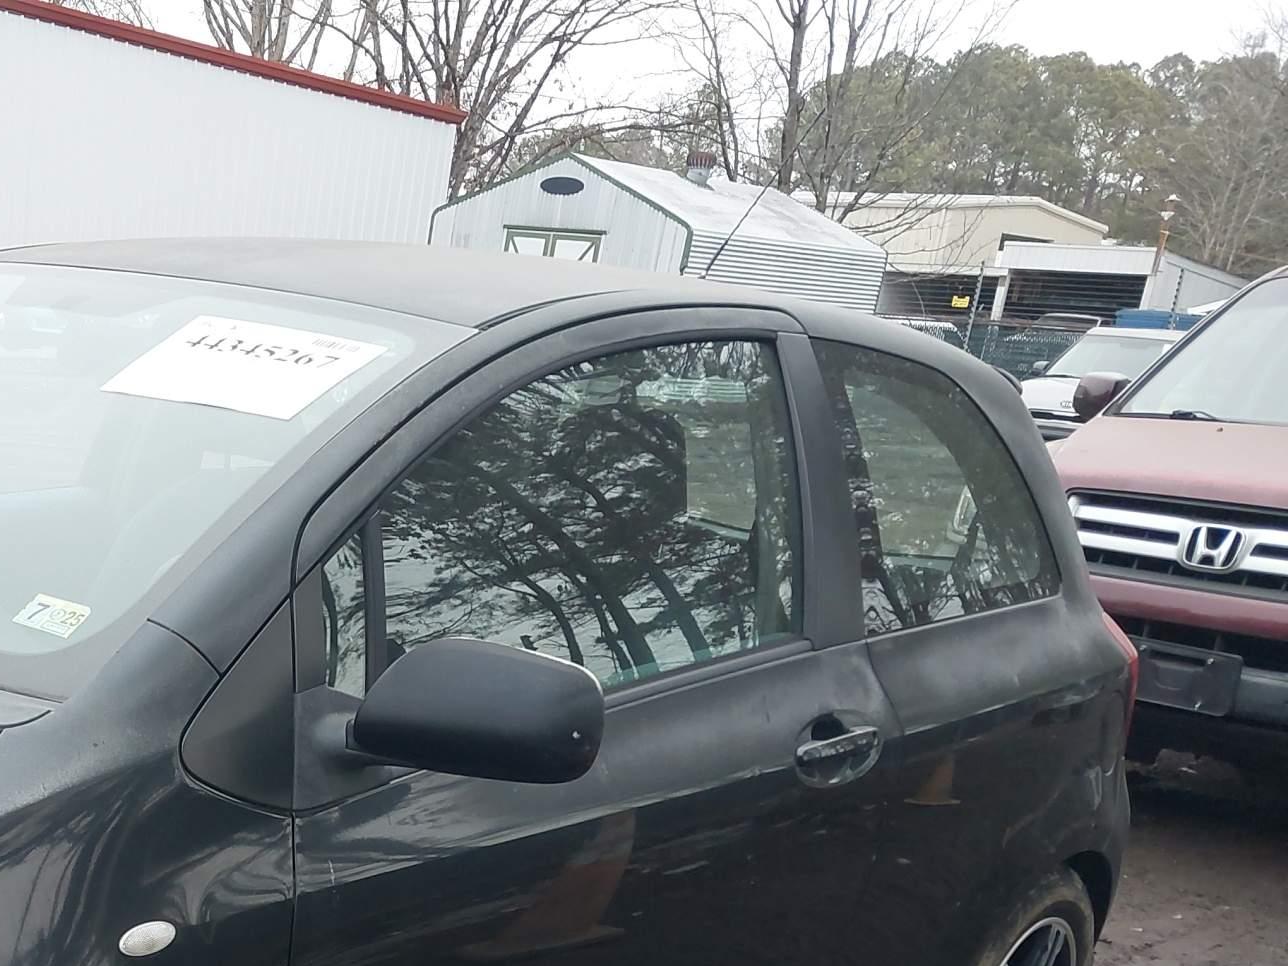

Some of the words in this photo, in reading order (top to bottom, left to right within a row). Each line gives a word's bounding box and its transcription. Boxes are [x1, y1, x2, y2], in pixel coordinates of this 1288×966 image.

[185, 335, 341, 368] 44345267
[27, 602, 51, 620] 7
[59, 610, 86, 627] 25
